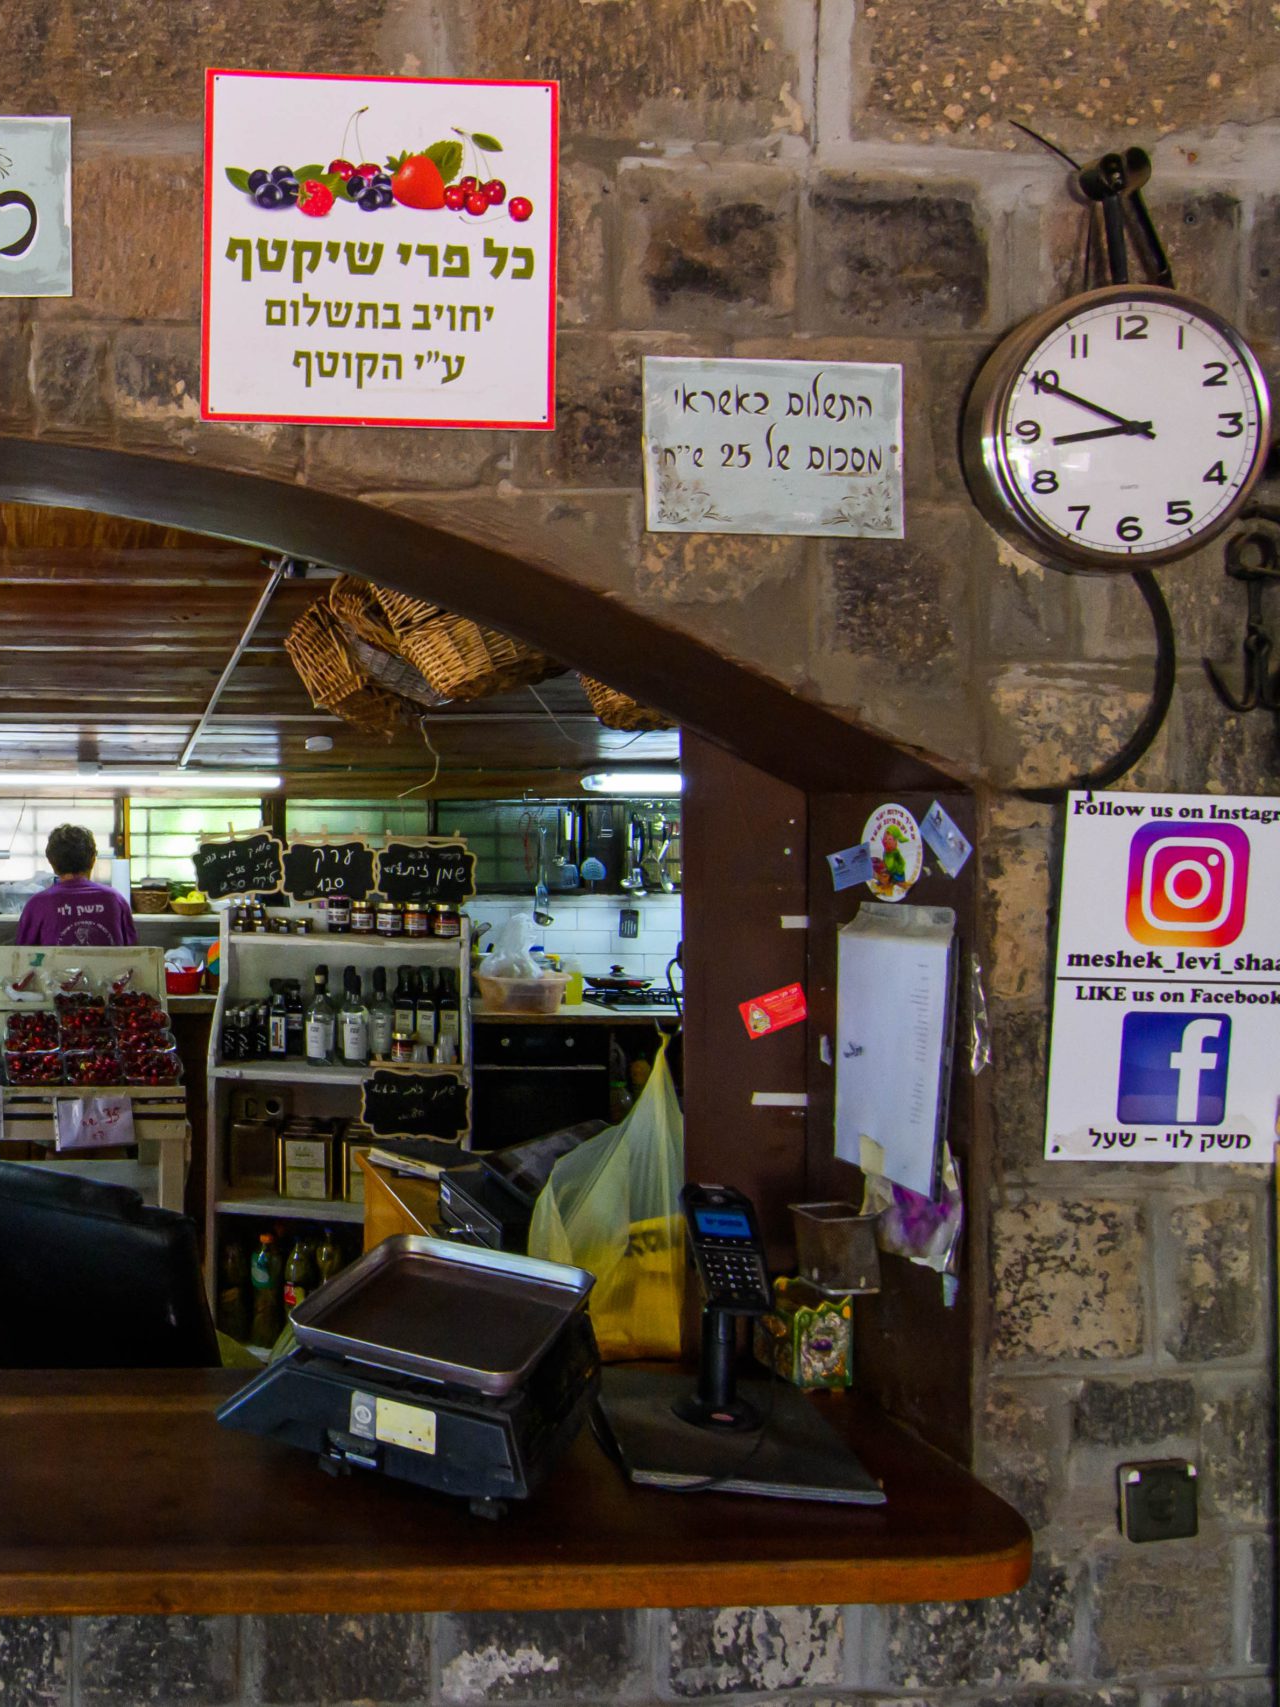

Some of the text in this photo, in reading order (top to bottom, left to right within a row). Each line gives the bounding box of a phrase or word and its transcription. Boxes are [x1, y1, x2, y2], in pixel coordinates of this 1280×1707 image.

[225, 236, 535, 283] כל פרי שיקטף
[265, 293, 495, 332] יחויב בתשלום
[1116, 314, 1148, 340] 12
[292, 350, 404, 389] הקוטף
[1202, 362, 1228, 387] 2
[786, 371, 872, 422] התשלום
[1015, 420, 1041, 444] 9
[1217, 412, 1243, 438] 3
[720, 443, 752, 468] 25
[766, 422, 791, 470] של
[806, 445, 883, 474] מסכום
[1031, 469, 1059, 494] 8
[1202, 460, 1228, 485] 4
[1068, 505, 1090, 530] 7
[1165, 500, 1193, 525] 5
[1116, 516, 1143, 542] 6
[1073, 800, 1145, 818] Follow
[1150, 805, 1173, 818] us
[1179, 806, 1203, 819] on
[1075, 986, 1280, 1005] LIKE us on Facebook
[1088, 1127, 1251, 1152] משק לוי שעל
